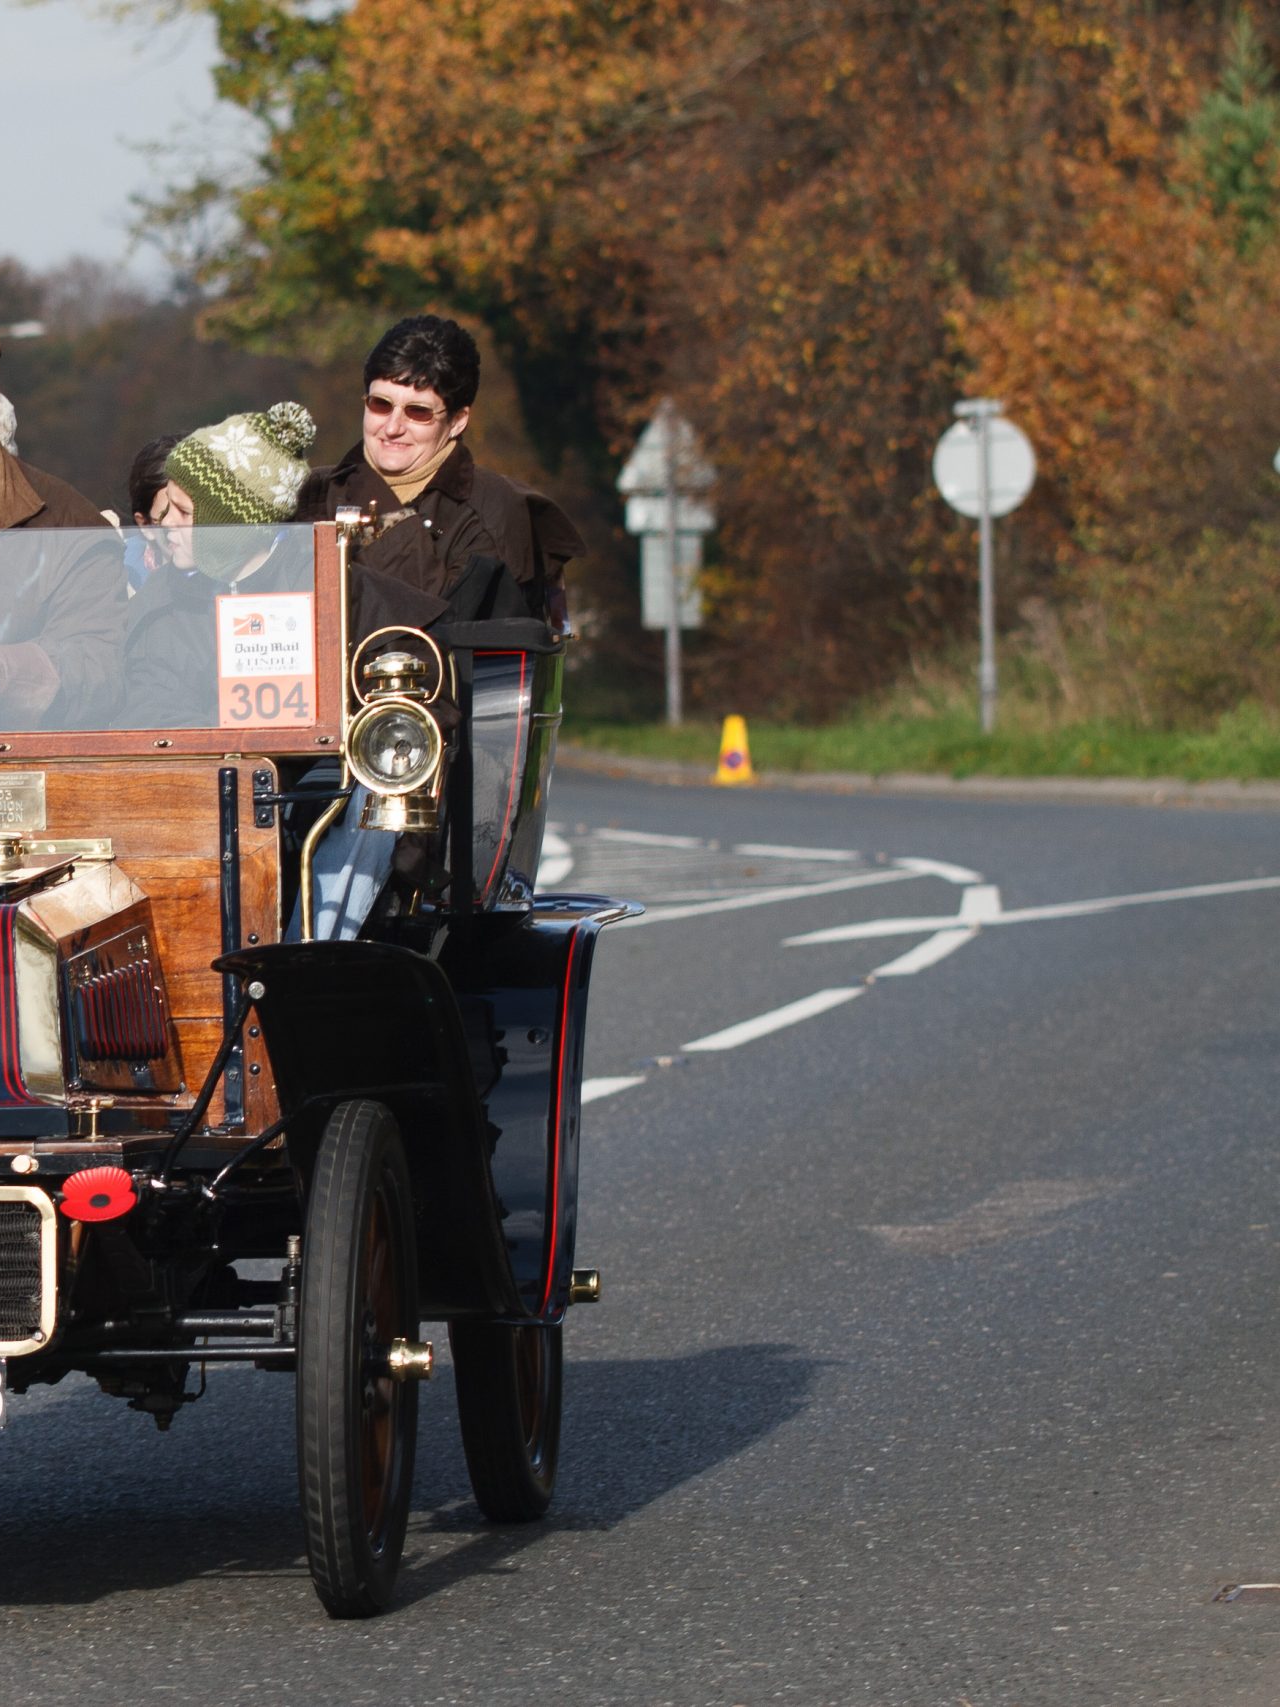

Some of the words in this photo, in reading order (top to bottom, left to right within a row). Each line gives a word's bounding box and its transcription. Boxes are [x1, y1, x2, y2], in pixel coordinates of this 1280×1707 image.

[234, 643, 268, 656] Daily
[270, 642, 300, 652] Mail
[229, 681, 309, 721] 304
